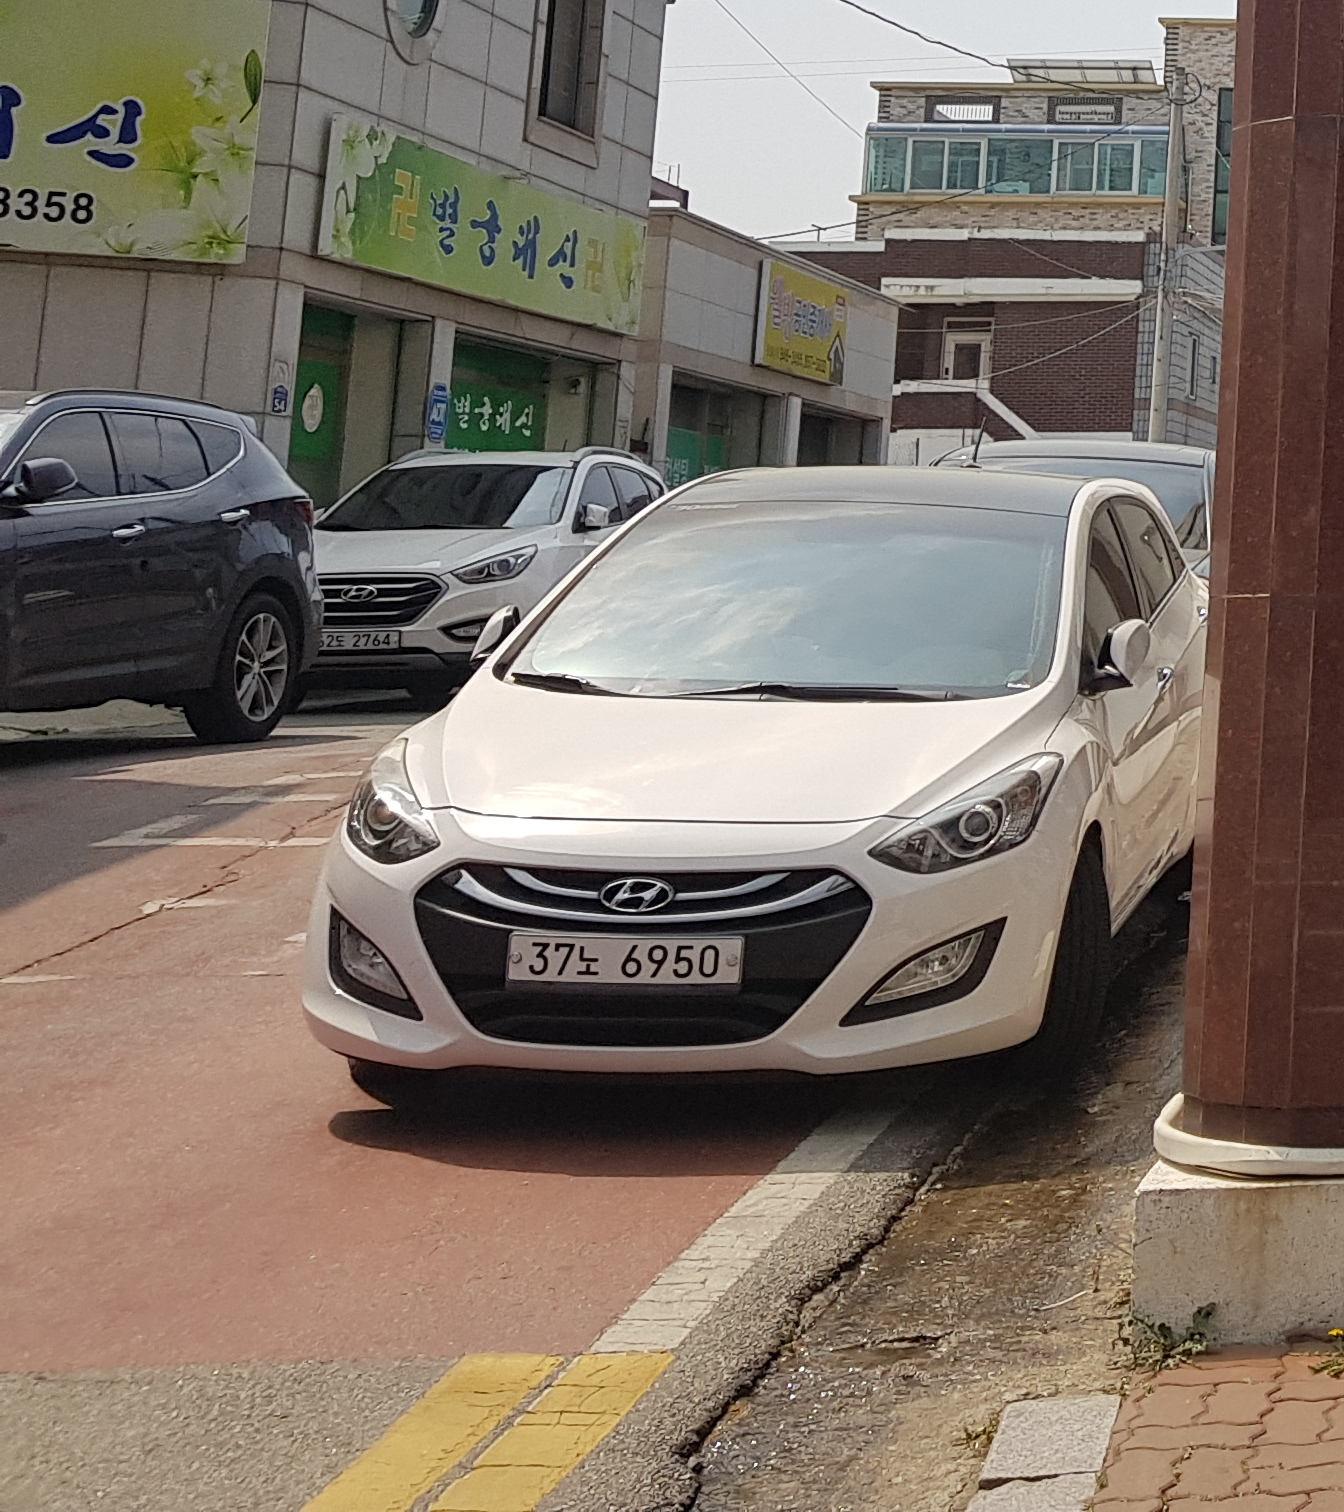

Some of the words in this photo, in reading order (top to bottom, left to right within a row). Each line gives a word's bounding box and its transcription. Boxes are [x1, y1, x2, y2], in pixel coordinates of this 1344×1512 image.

[320, 633, 345, 648] 2도
[352, 633, 391, 648] 2764
[528, 942, 599, 976] 37노
[620, 944, 720, 978] 6950
